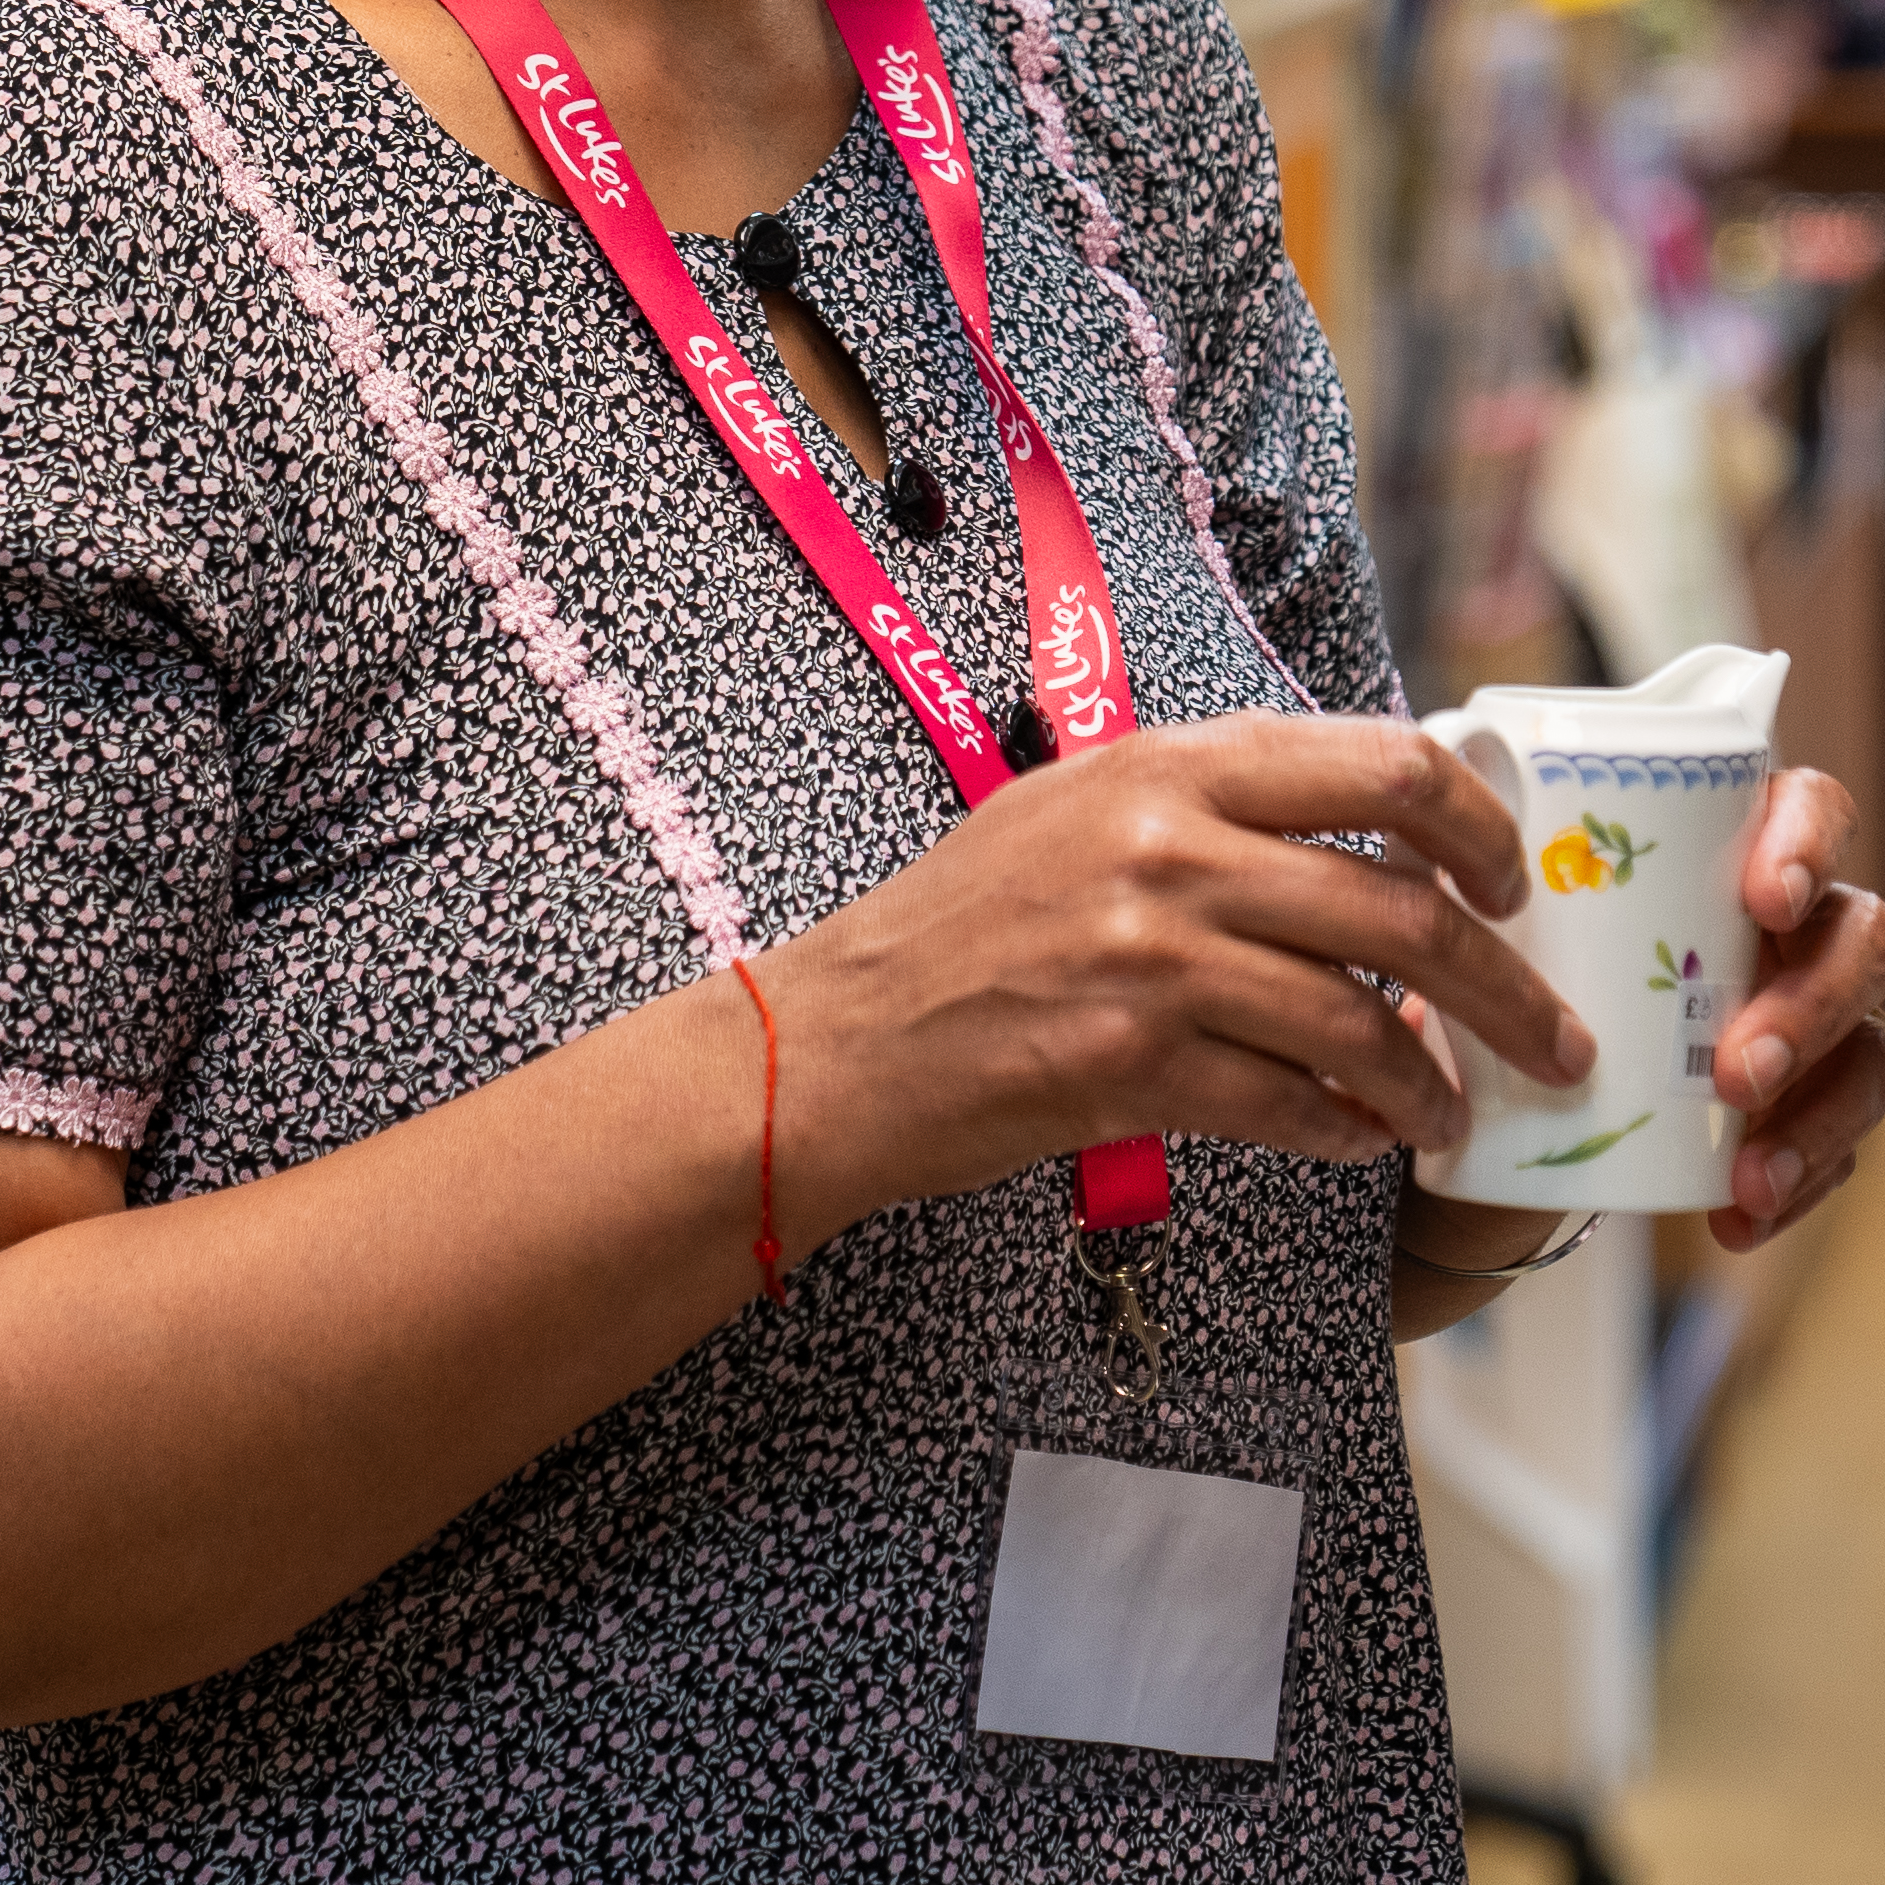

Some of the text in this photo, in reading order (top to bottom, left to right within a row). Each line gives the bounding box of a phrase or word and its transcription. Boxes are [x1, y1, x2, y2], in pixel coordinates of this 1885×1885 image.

[517, 54, 627, 209] St Luke's
[877, 44, 966, 185] St Luke's
[685, 335, 801, 480] St Luke's
[870, 604, 983, 755] St Luke's
[1039, 584, 1117, 738] St Luke's
